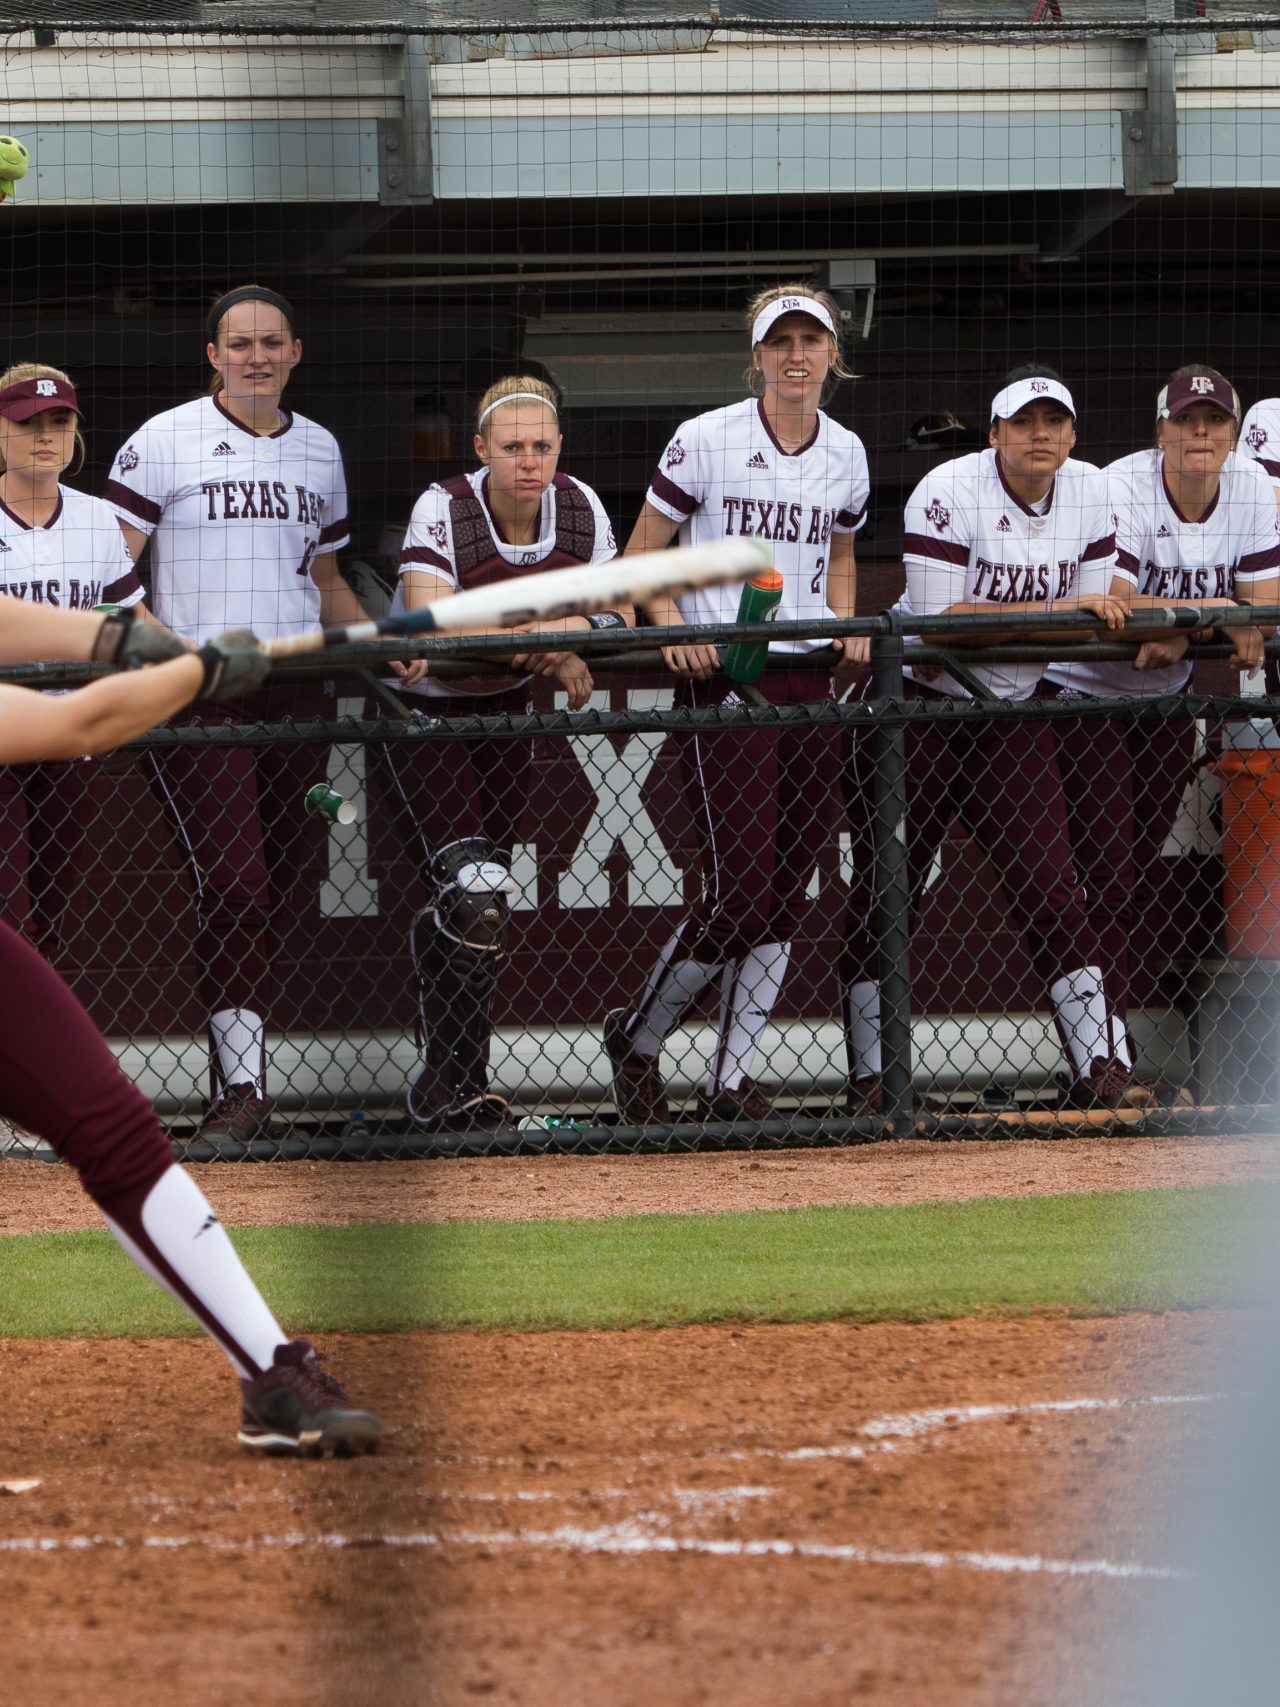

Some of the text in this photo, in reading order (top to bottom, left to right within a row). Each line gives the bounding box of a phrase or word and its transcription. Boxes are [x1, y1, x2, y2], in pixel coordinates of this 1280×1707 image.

[746, 461, 769, 470] adidas
[202, 480, 290, 521] TEXAS
[723, 495, 803, 542] TEXAS
[811, 556, 826, 594] 2
[972, 557, 1050, 603] TEXAS
[1140, 559, 1209, 600] TEXAS
